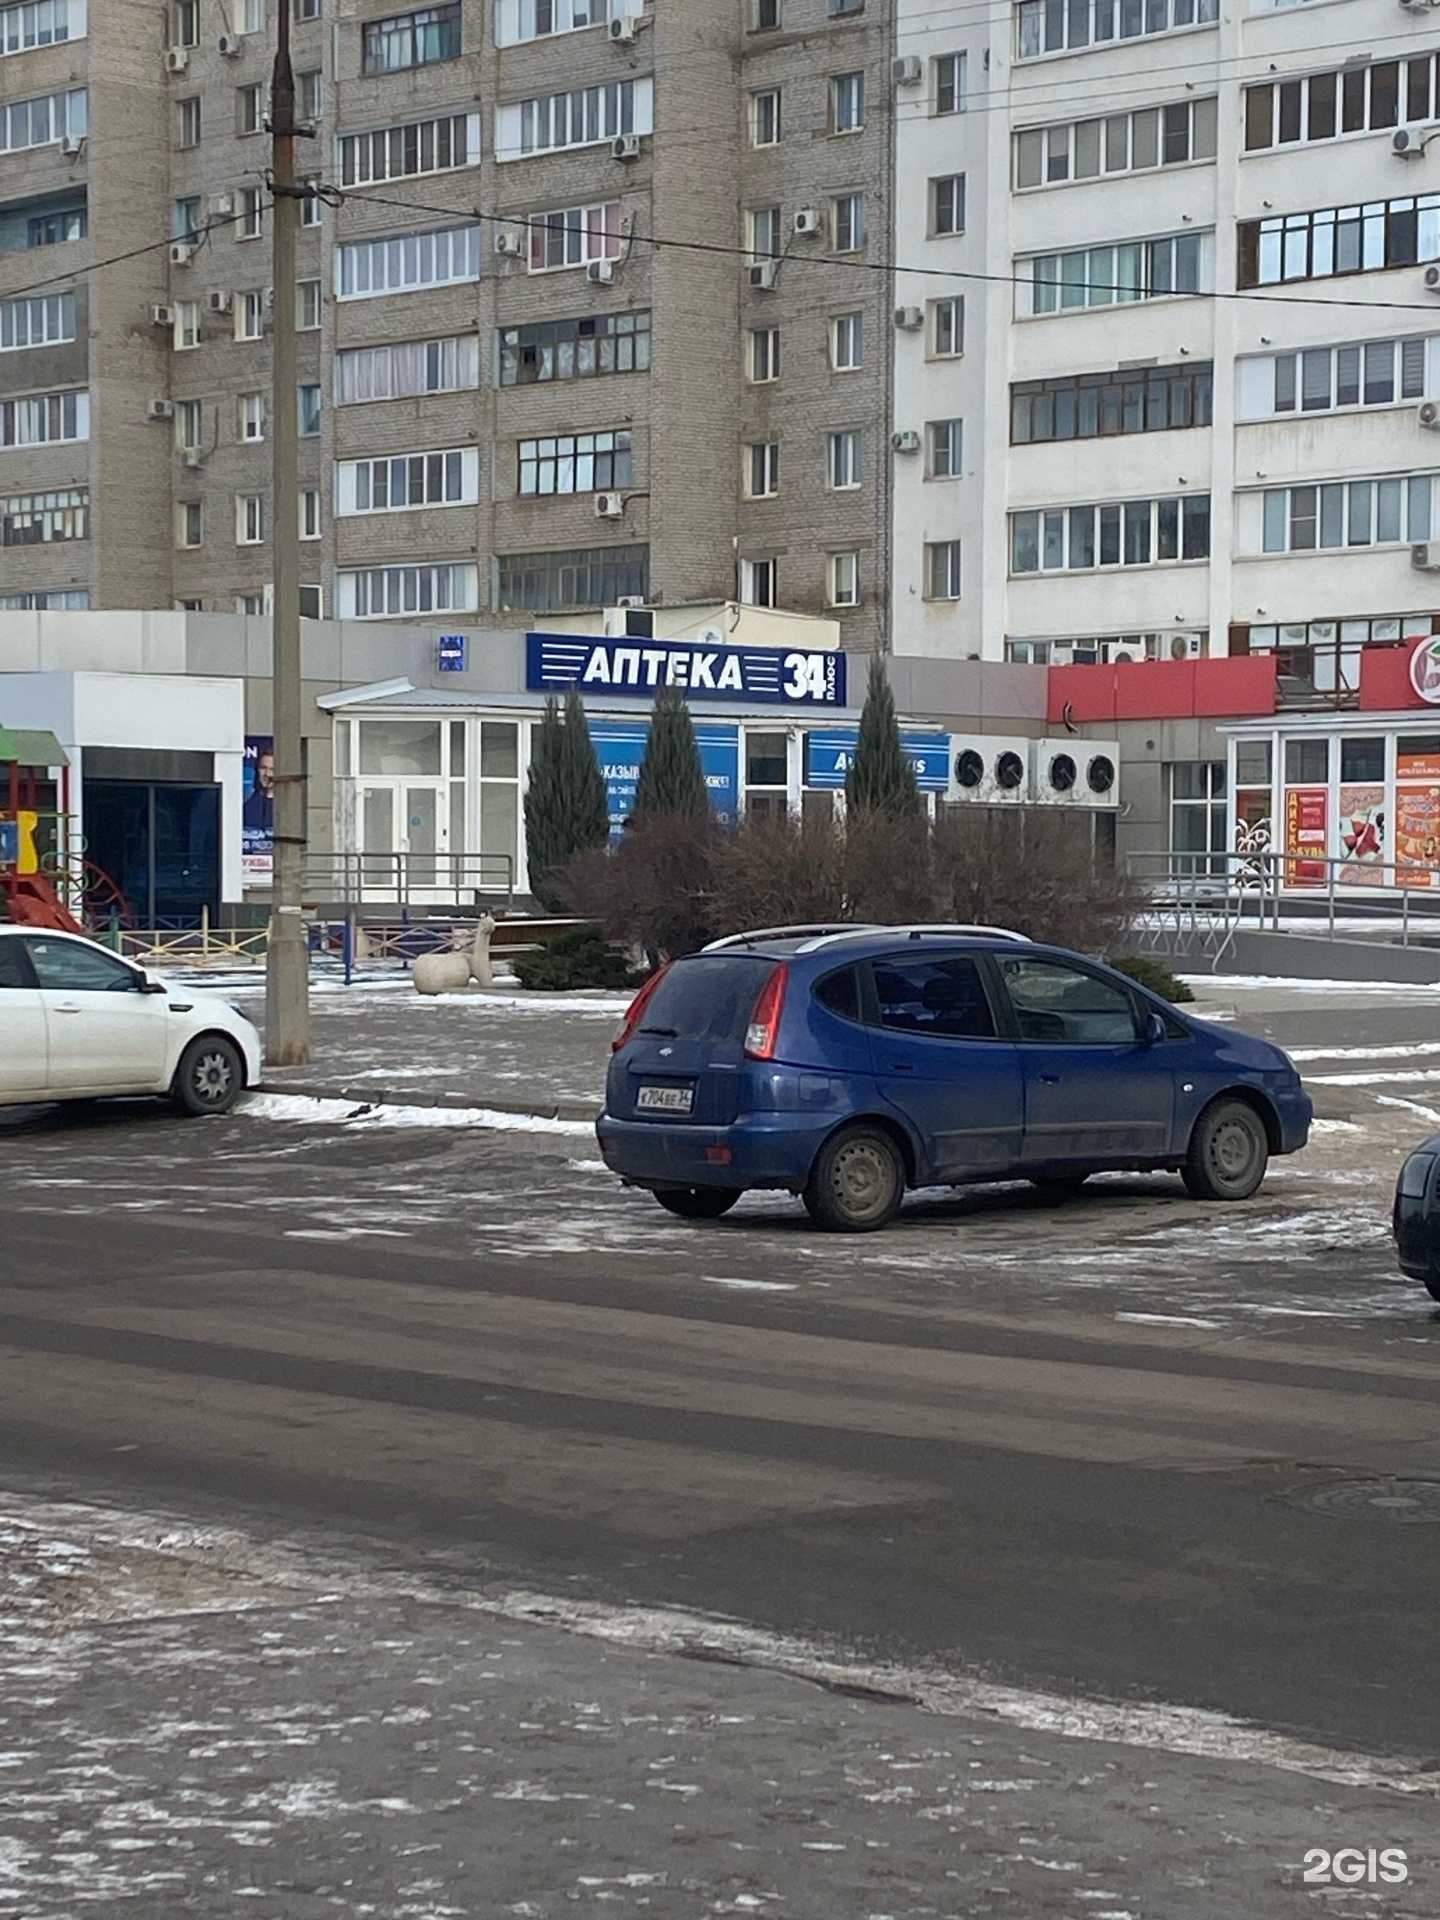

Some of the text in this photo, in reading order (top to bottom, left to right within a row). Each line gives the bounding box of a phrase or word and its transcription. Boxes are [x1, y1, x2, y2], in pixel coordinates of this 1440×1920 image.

[583, 646, 827, 699] АПТЕКА 34
[826, 655, 836, 700] ПЛЮС
